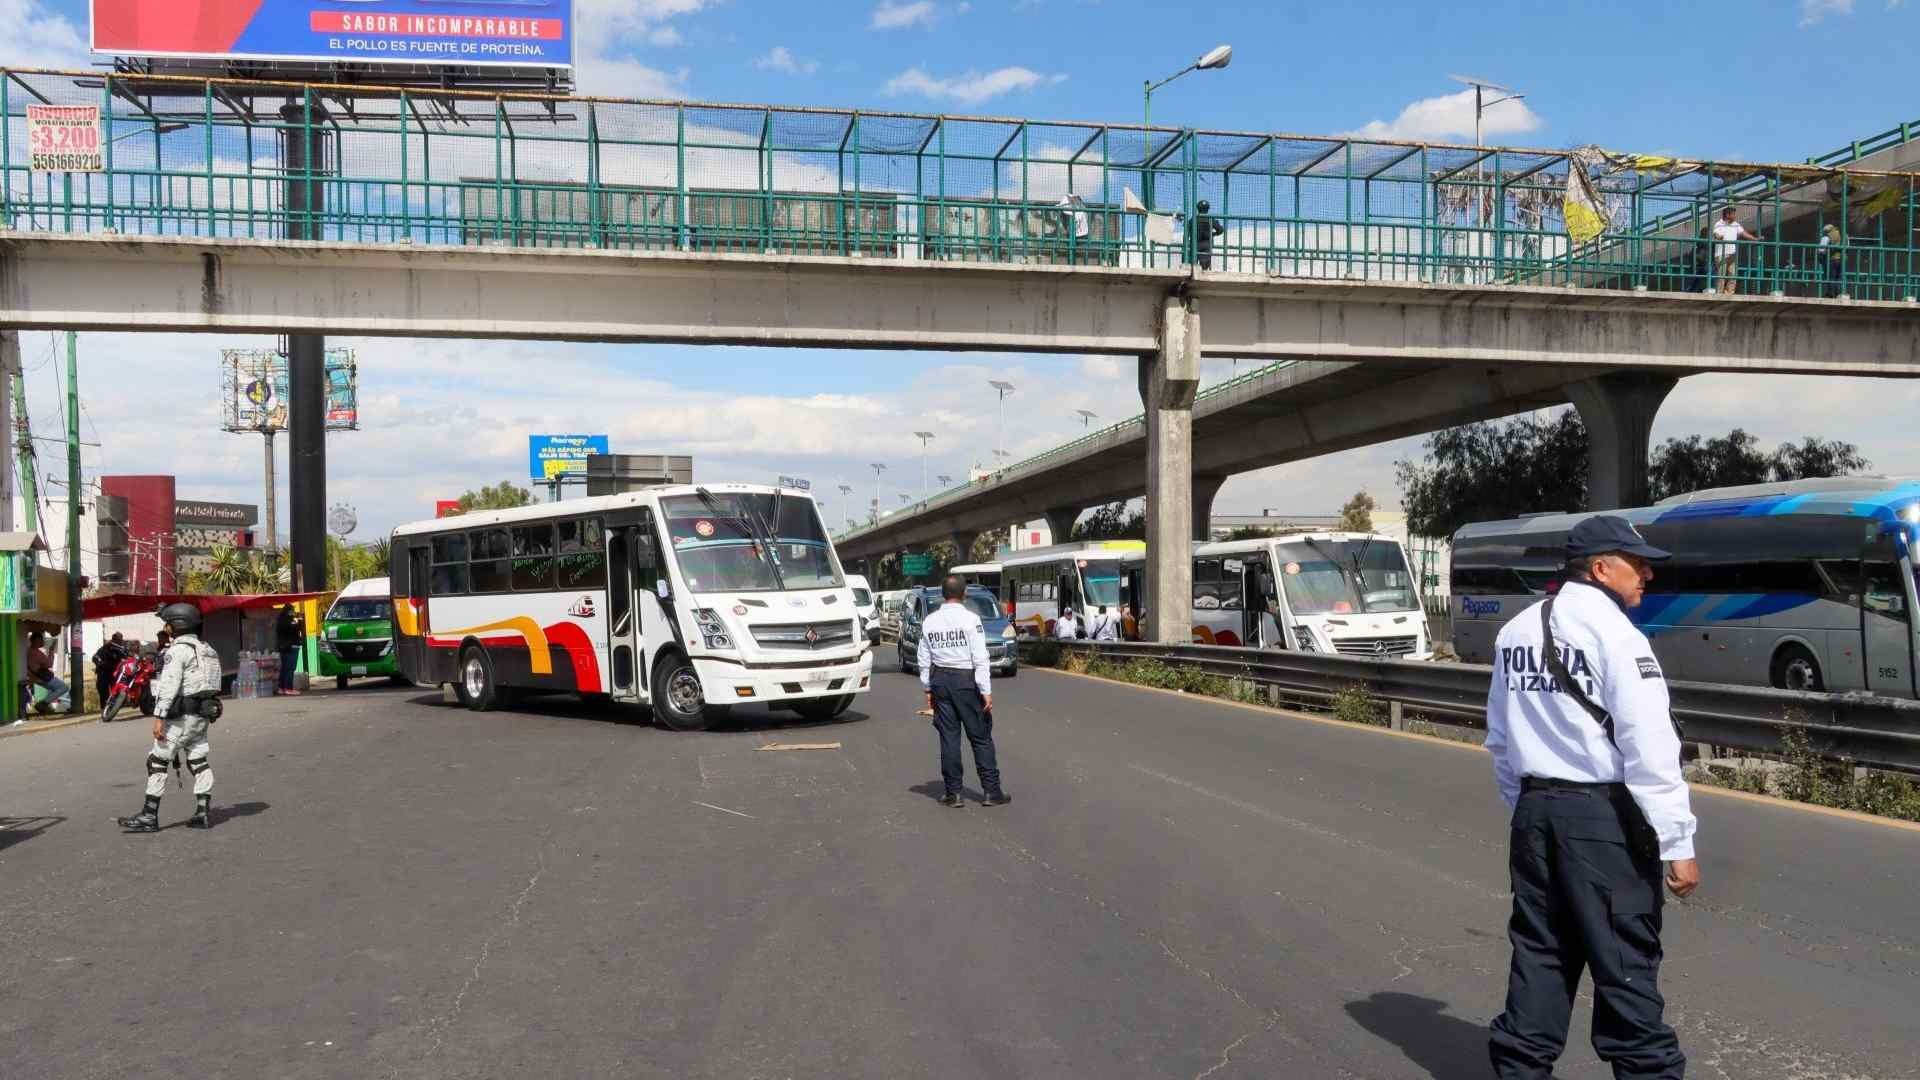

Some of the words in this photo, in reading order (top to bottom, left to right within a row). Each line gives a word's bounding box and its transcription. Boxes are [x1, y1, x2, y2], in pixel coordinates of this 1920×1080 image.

[343, 15, 398, 32] SABOR
[408, 18, 539, 37] INCOMPARABLE
[329, 39, 344, 49] EL
[347, 39, 387, 50] POLLO
[391, 41, 407, 51] ES
[410, 41, 458, 53] FUENTE
[461, 43, 478, 53] DE
[481, 43, 544, 56] PROTEÍNA.
